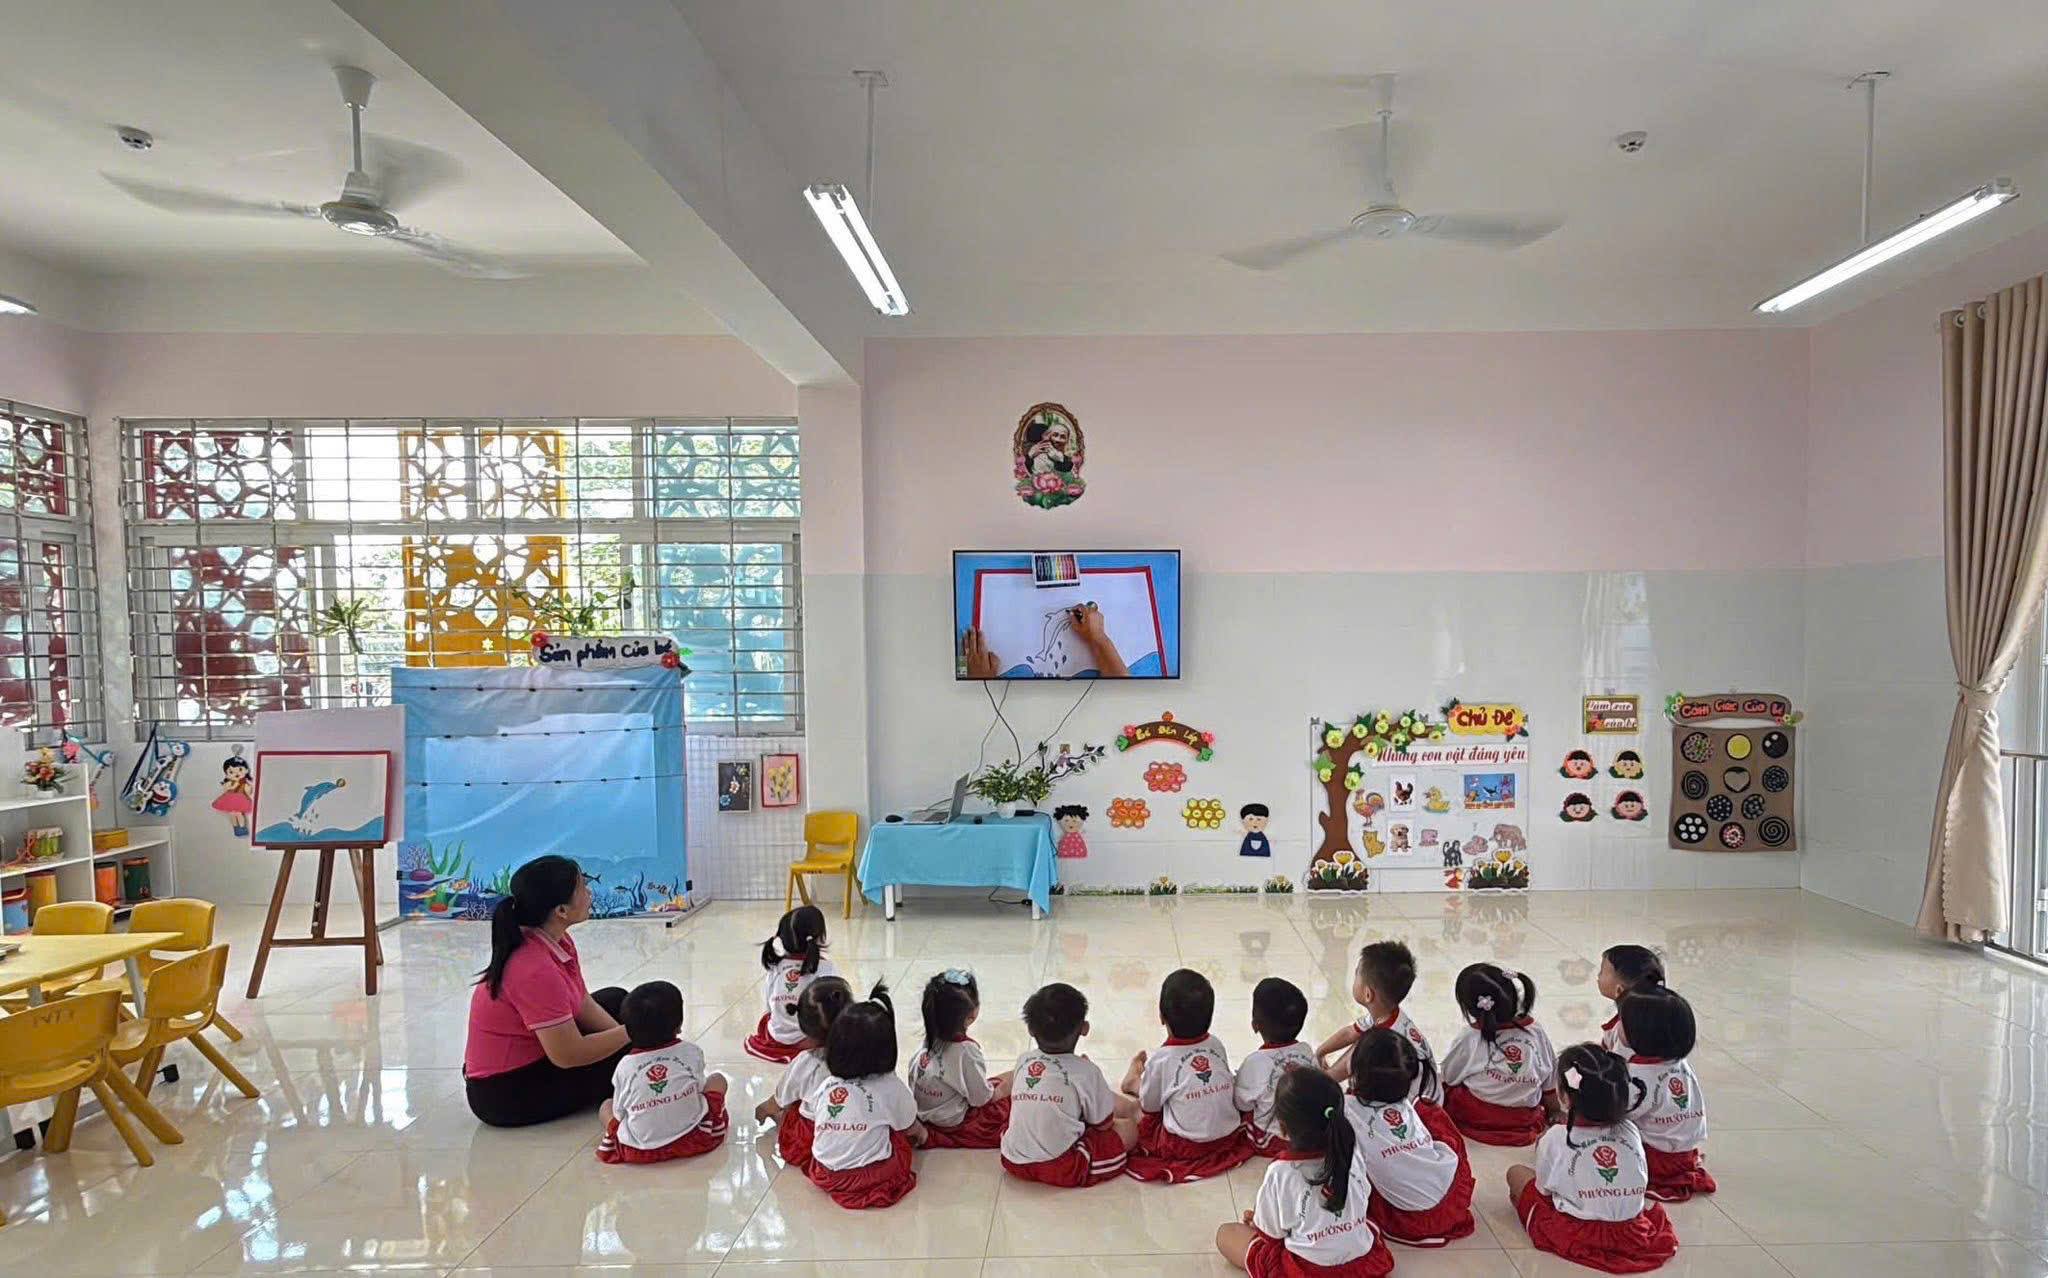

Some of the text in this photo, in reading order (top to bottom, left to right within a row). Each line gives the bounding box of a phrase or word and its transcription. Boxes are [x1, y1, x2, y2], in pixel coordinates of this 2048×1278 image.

[1457, 706, 1487, 726] Chủ
[1422, 751, 1441, 761] con
[1446, 748, 1465, 764] vật
[1469, 746, 1499, 763] đáng
[1503, 748, 1525, 763] yêu
[843, 1123, 868, 1131] LAGI
[1578, 1188, 1621, 1198] PHƯỜNG
[1306, 1222, 1352, 1241] PHƯỜNG
